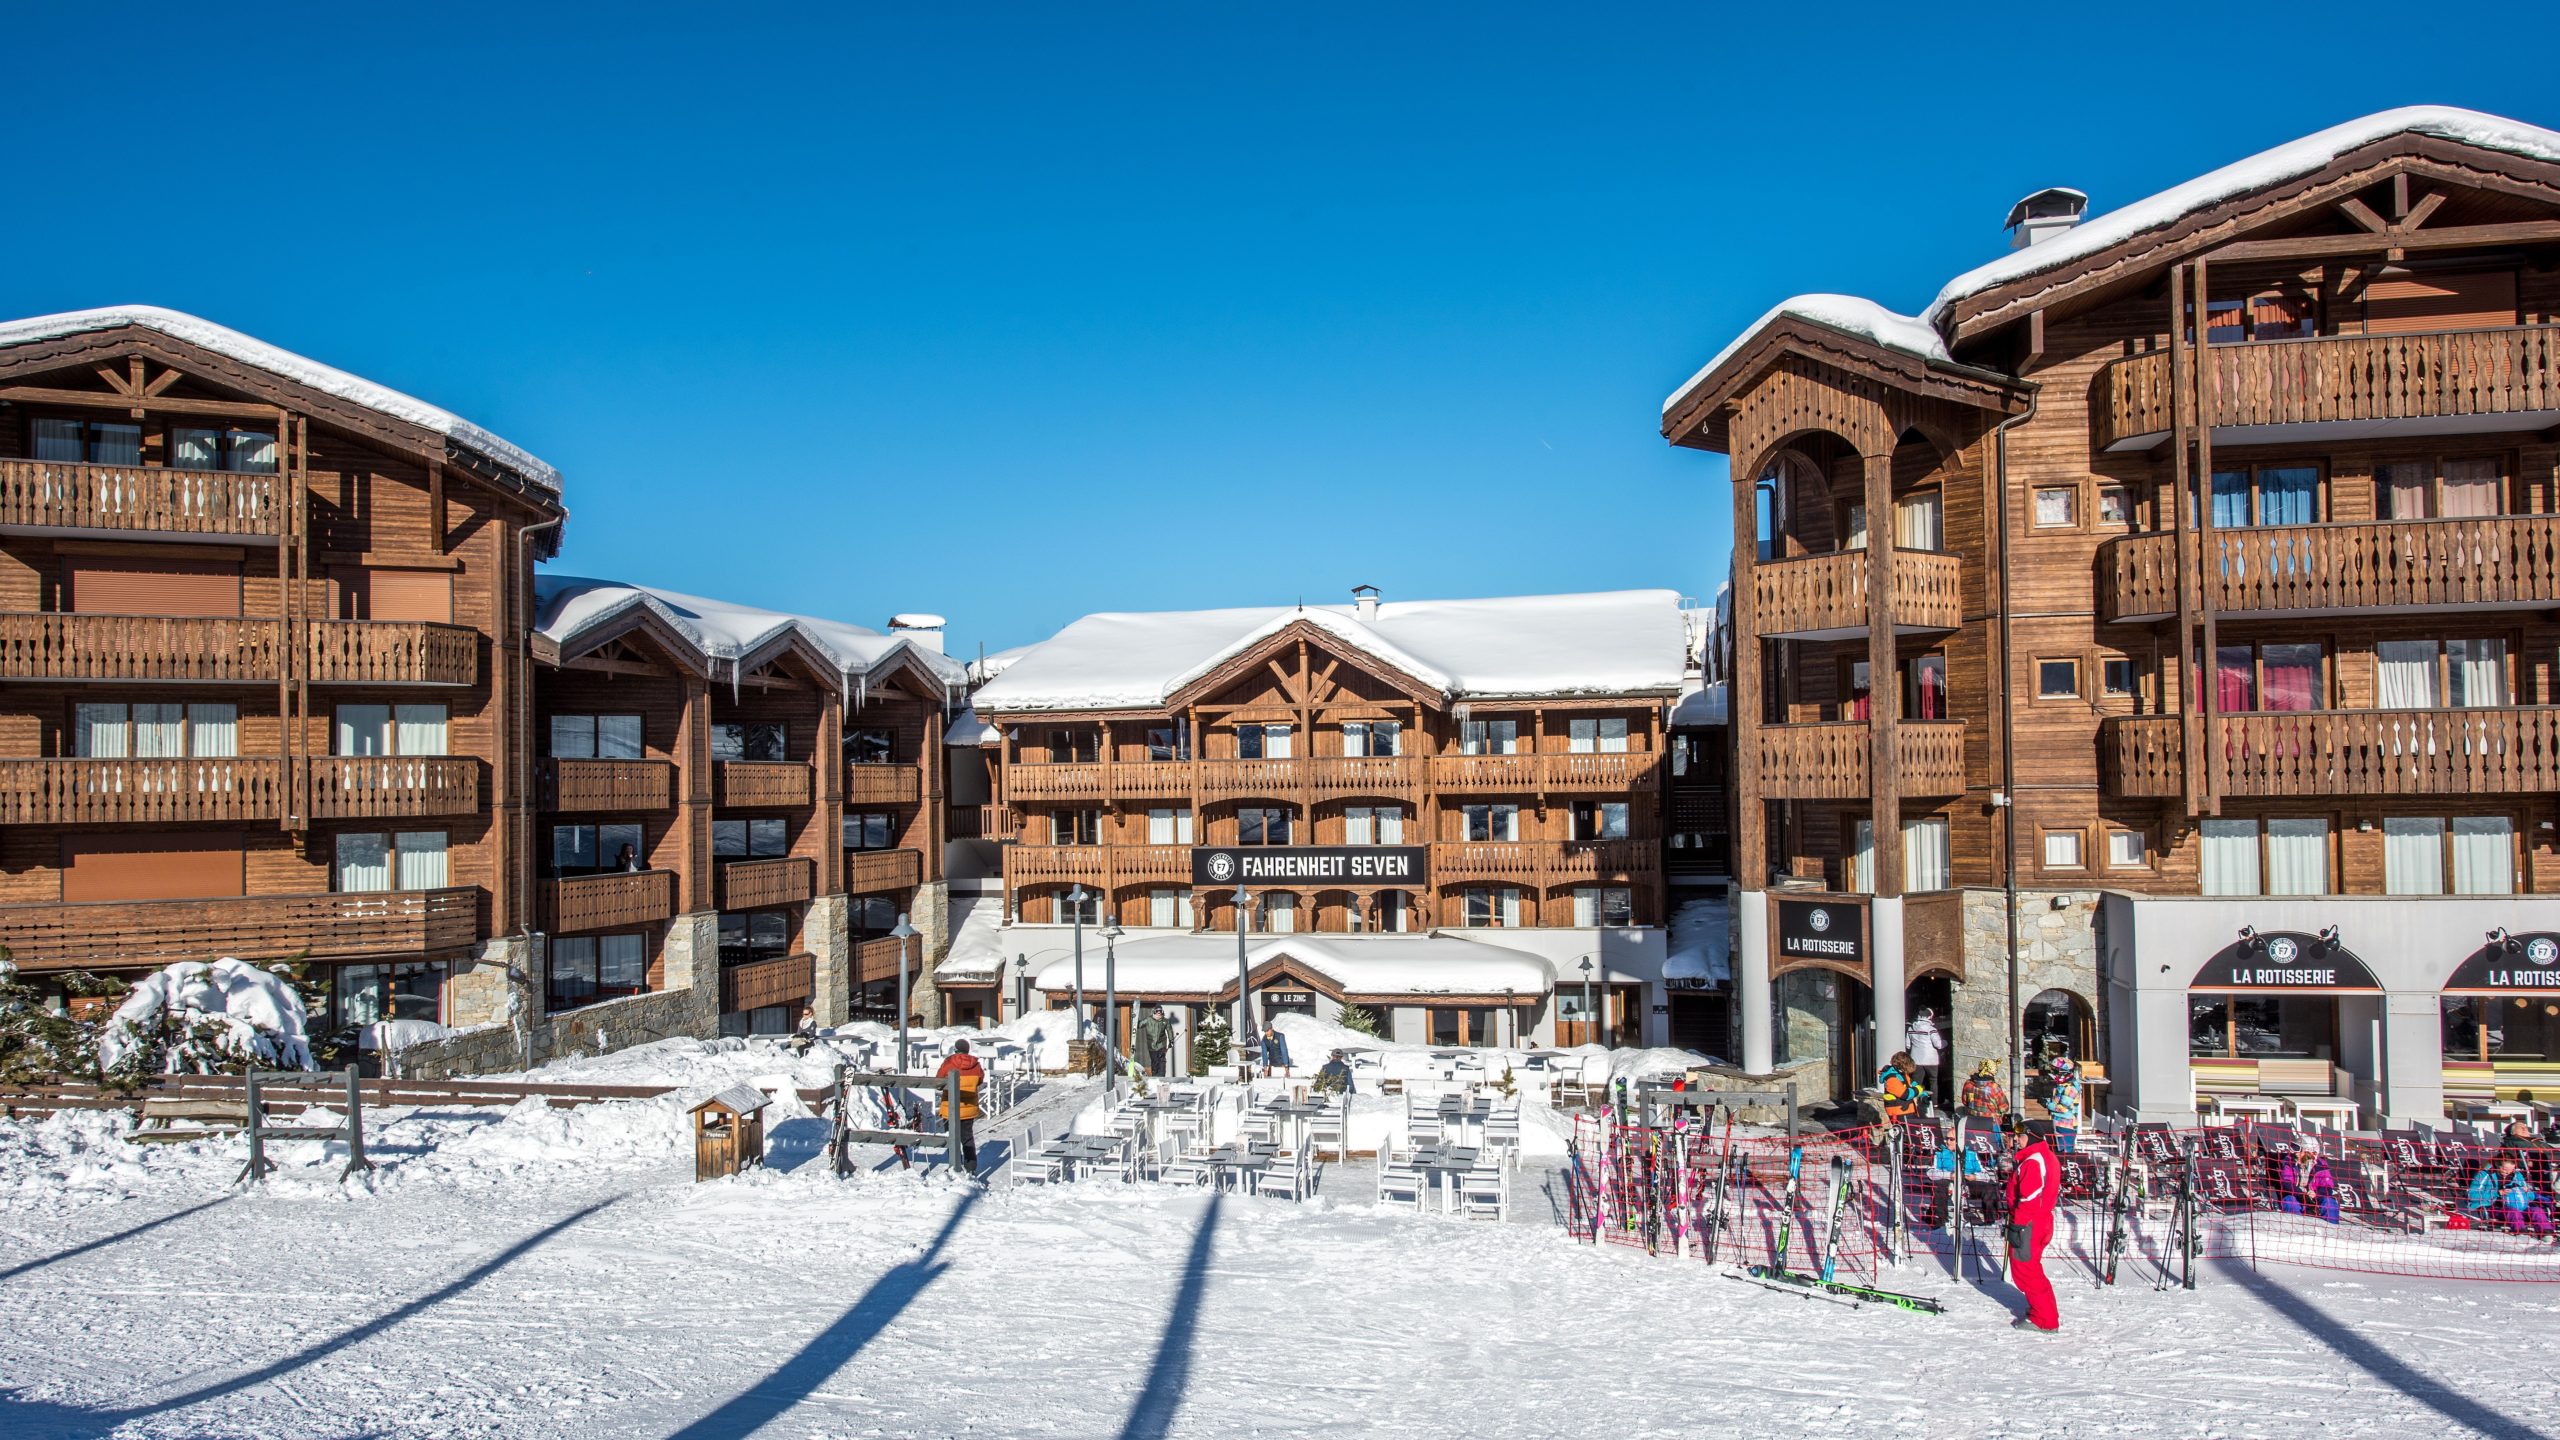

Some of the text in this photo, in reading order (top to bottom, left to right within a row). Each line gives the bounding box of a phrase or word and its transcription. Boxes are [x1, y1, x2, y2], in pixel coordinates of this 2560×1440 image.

[1216, 863, 1226, 872] F7
[1243, 856, 1409, 876] FAHRENHEIT SEVEN
[1787, 937, 1855, 955] LA ROTISSERIE
[2233, 968, 2336, 984] LA ROTISSERIE
[2489, 970, 2510, 986] LA
[1283, 994, 1292, 1003] LE
